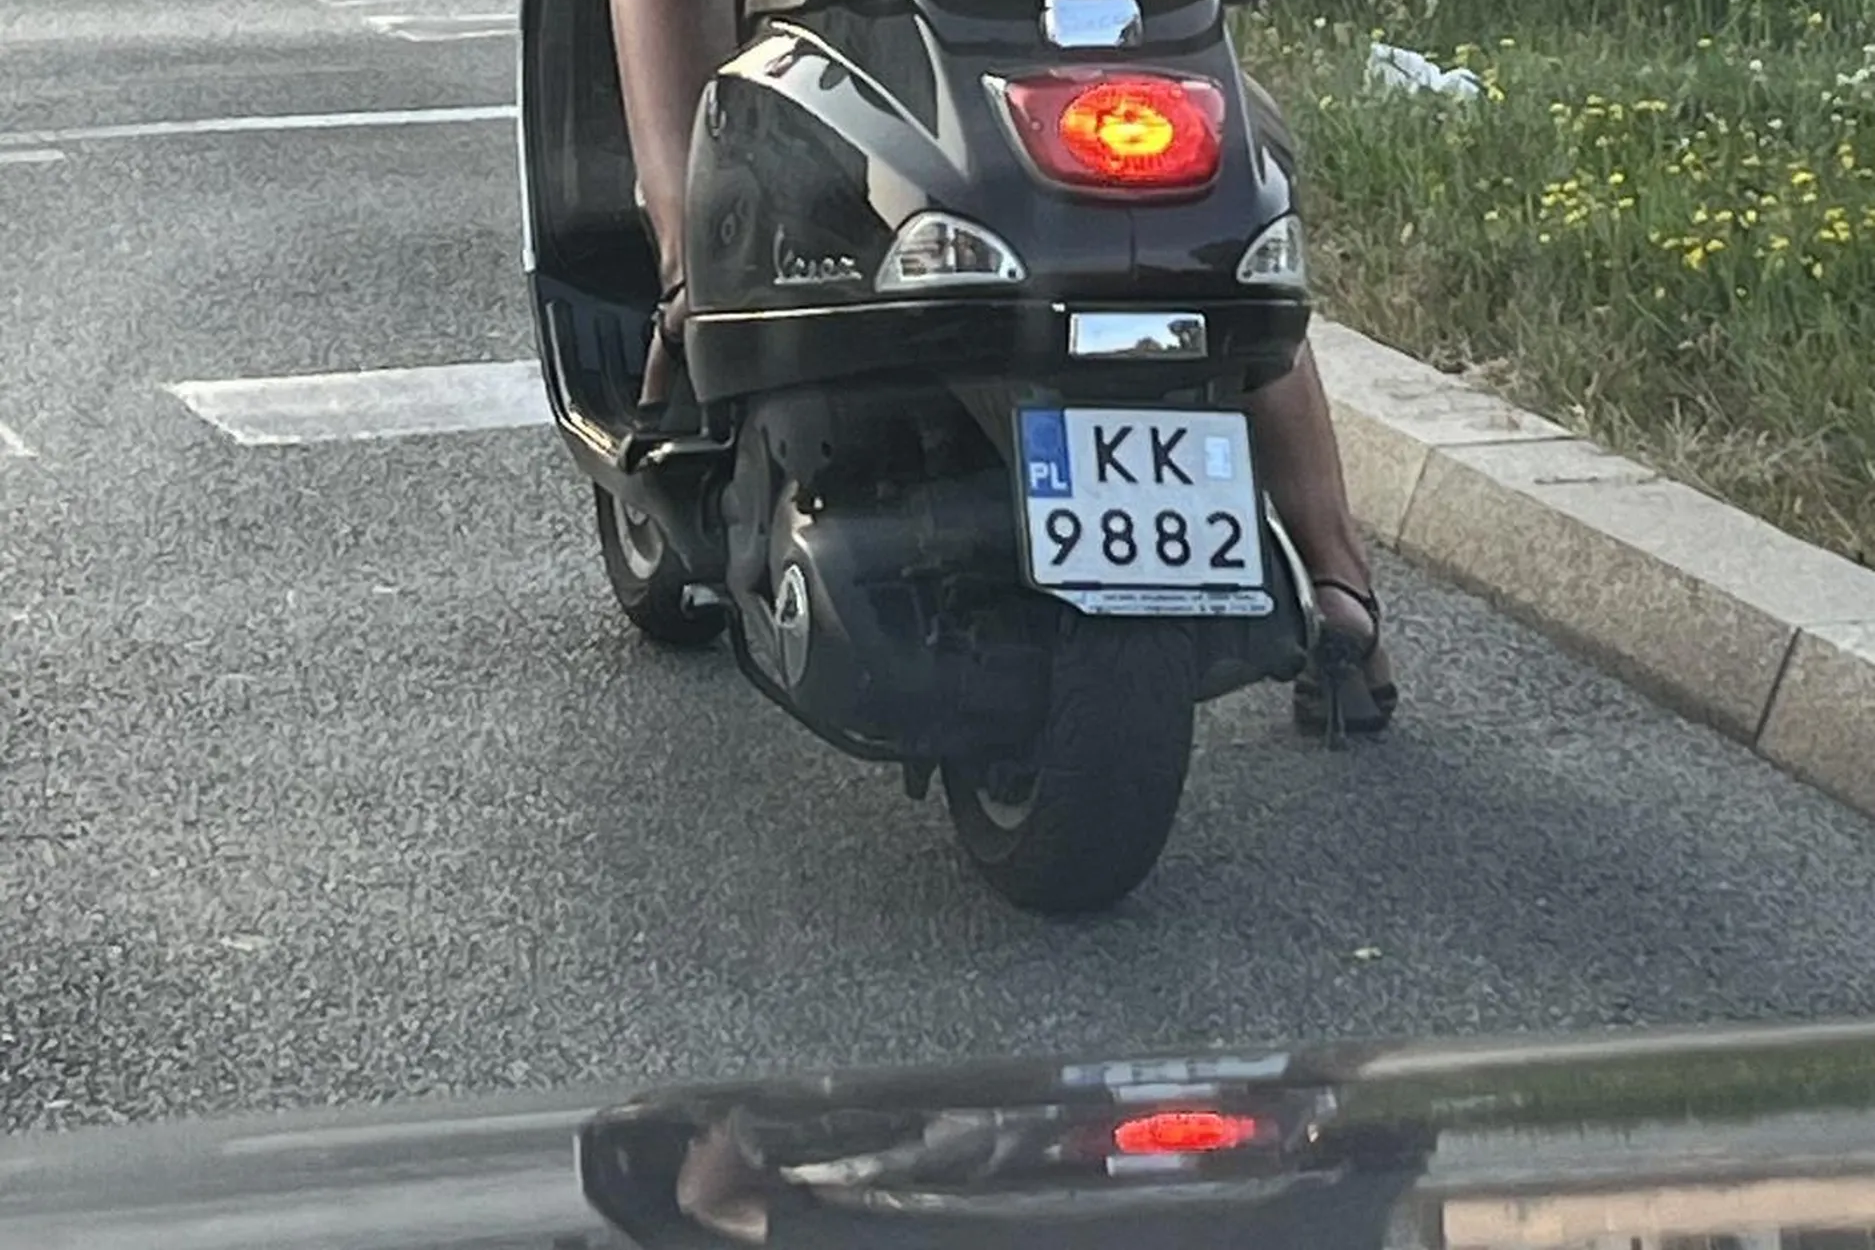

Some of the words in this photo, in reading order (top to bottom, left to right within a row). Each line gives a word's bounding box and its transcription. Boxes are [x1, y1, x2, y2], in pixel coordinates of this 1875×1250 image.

[1029, 462, 1069, 490] PL
[1094, 425, 1194, 485] KK
[1046, 508, 1245, 569] 9882
